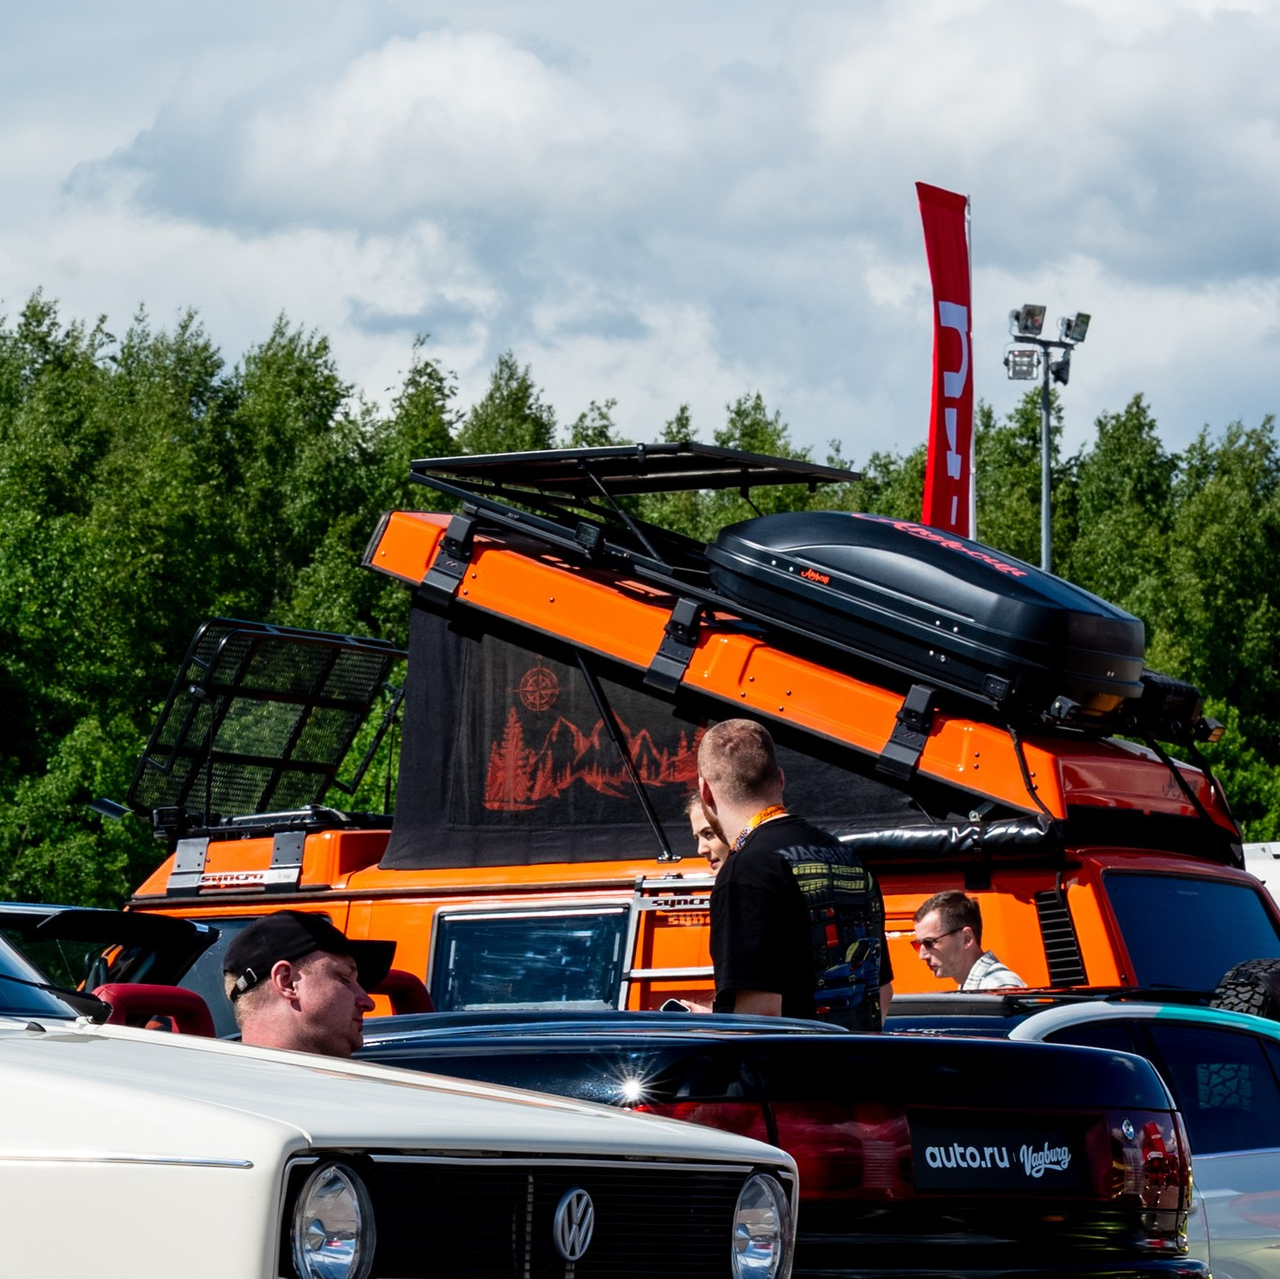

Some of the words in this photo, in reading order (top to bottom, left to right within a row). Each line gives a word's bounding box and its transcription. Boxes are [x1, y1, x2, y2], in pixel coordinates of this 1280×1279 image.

[201, 873, 264, 884] syncro
[652, 898, 710, 908] syncr
[925, 1143, 1010, 1168] auto.ru
[1020, 1142, 1071, 1178] Vagburg
